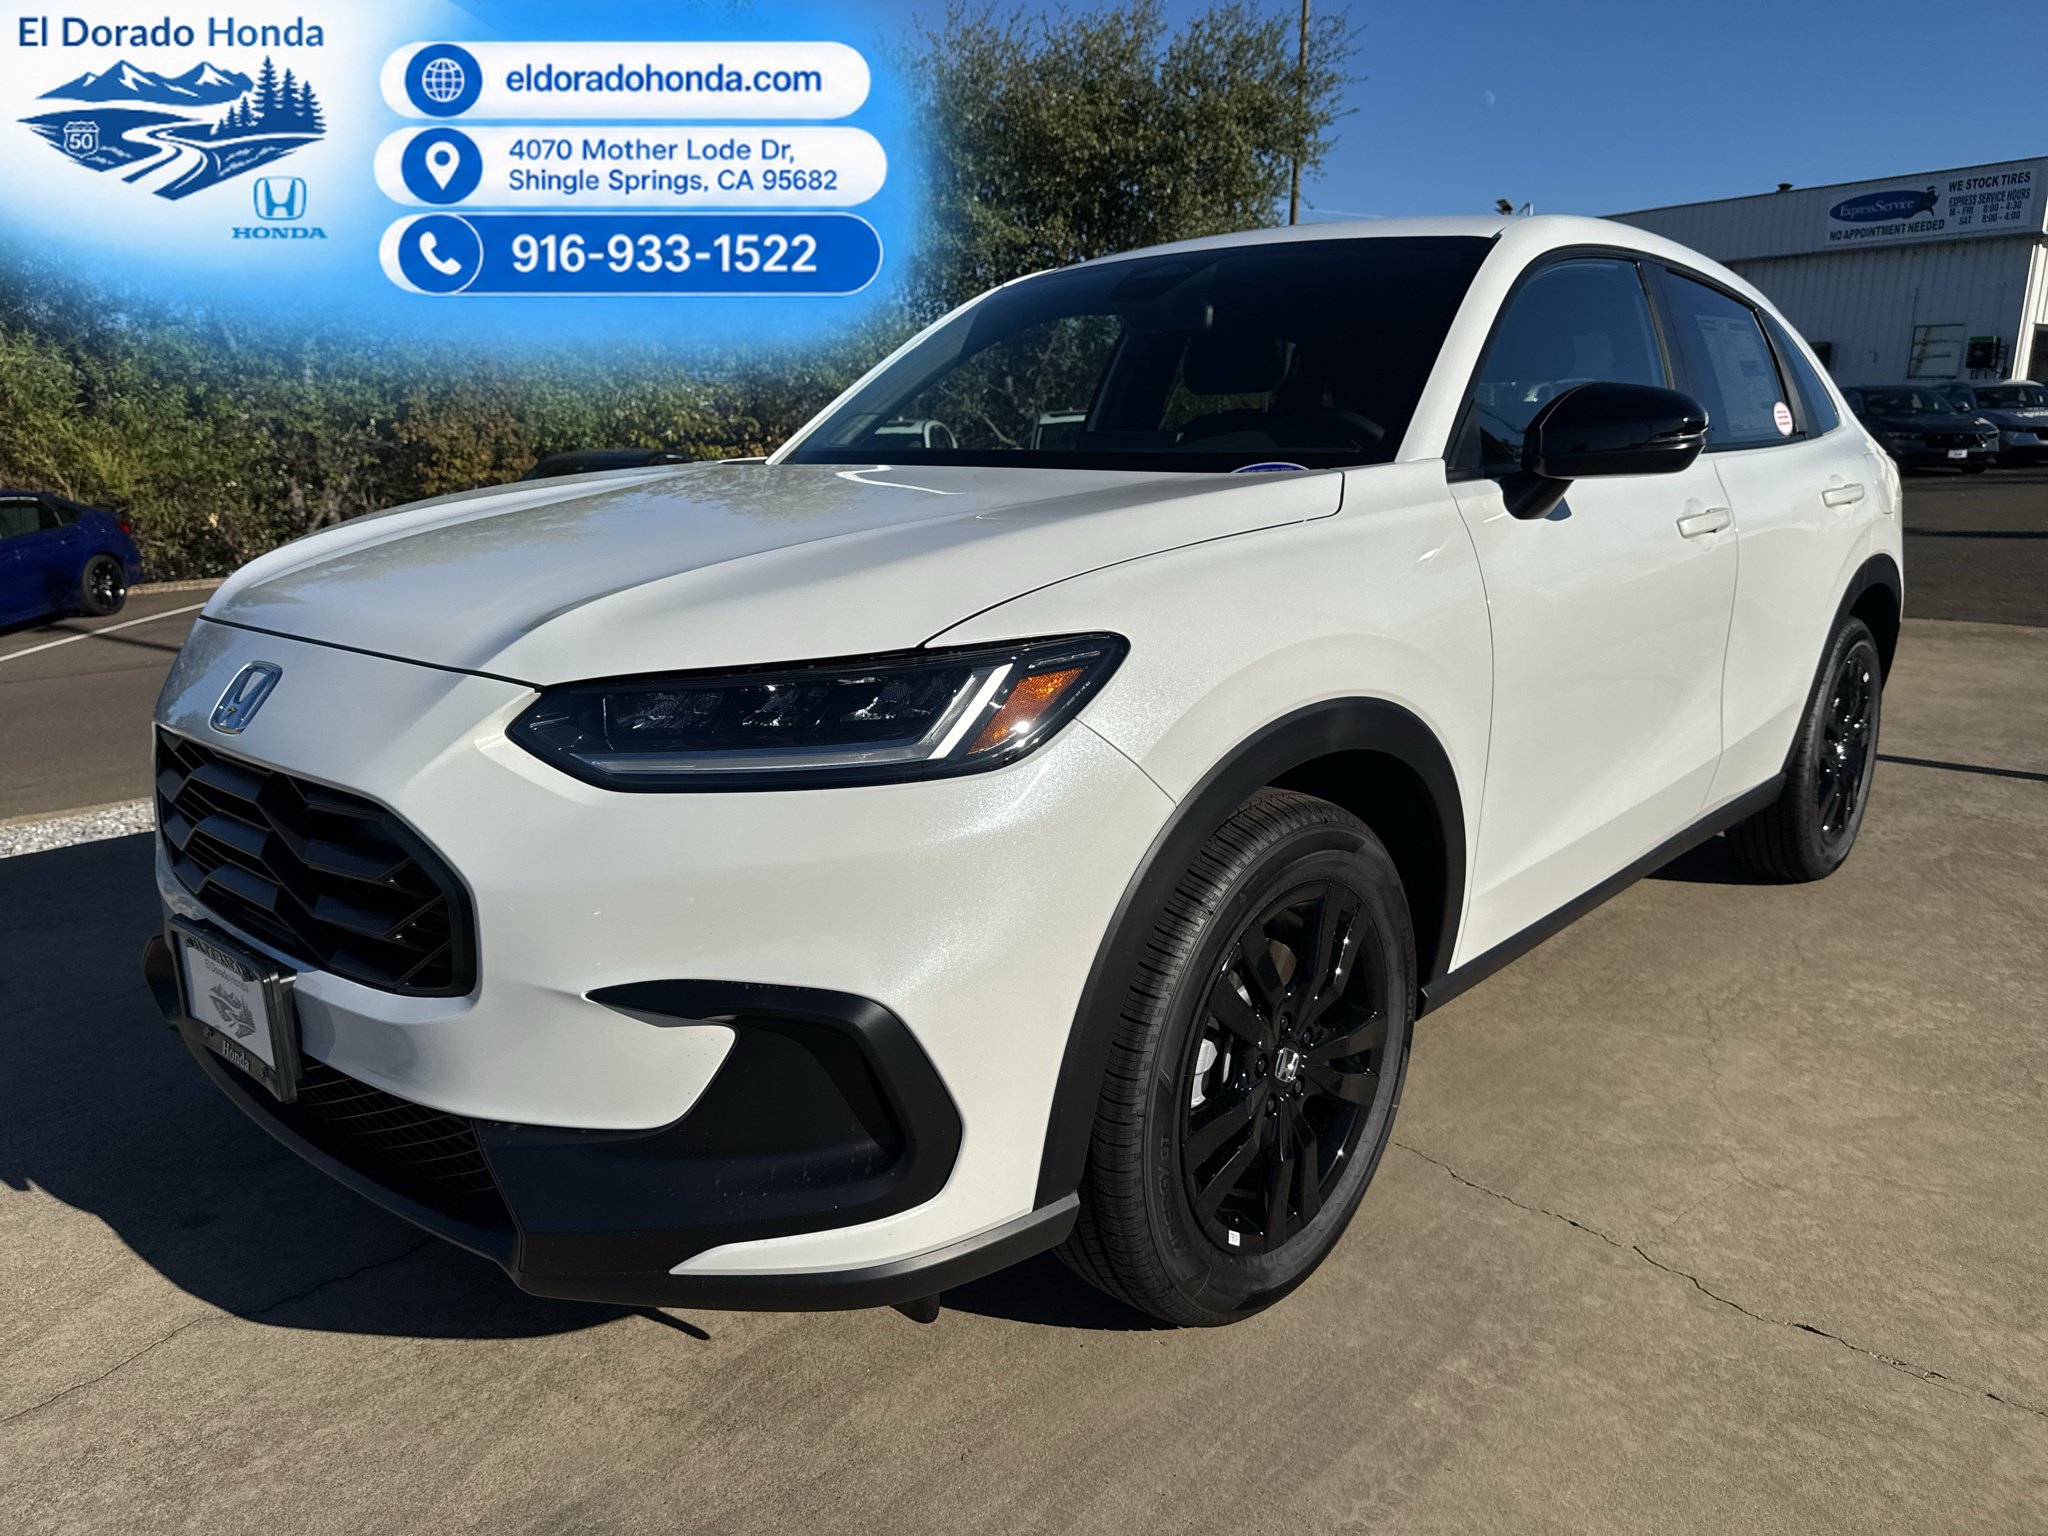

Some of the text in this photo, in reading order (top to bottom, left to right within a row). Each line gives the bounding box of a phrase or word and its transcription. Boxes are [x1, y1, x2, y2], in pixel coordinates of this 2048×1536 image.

[1949, 171, 2031, 192] WE STOCK TIRES
[1949, 188, 2031, 207] EXPRESS SERVICE HOURS
[1958, 215, 1973, 226] SAT
[1962, 205, 1974, 216] FRI
[1829, 219, 1945, 241] NO APPOINTMENT NEEDED
[222, 1040, 251, 1071] Honda
